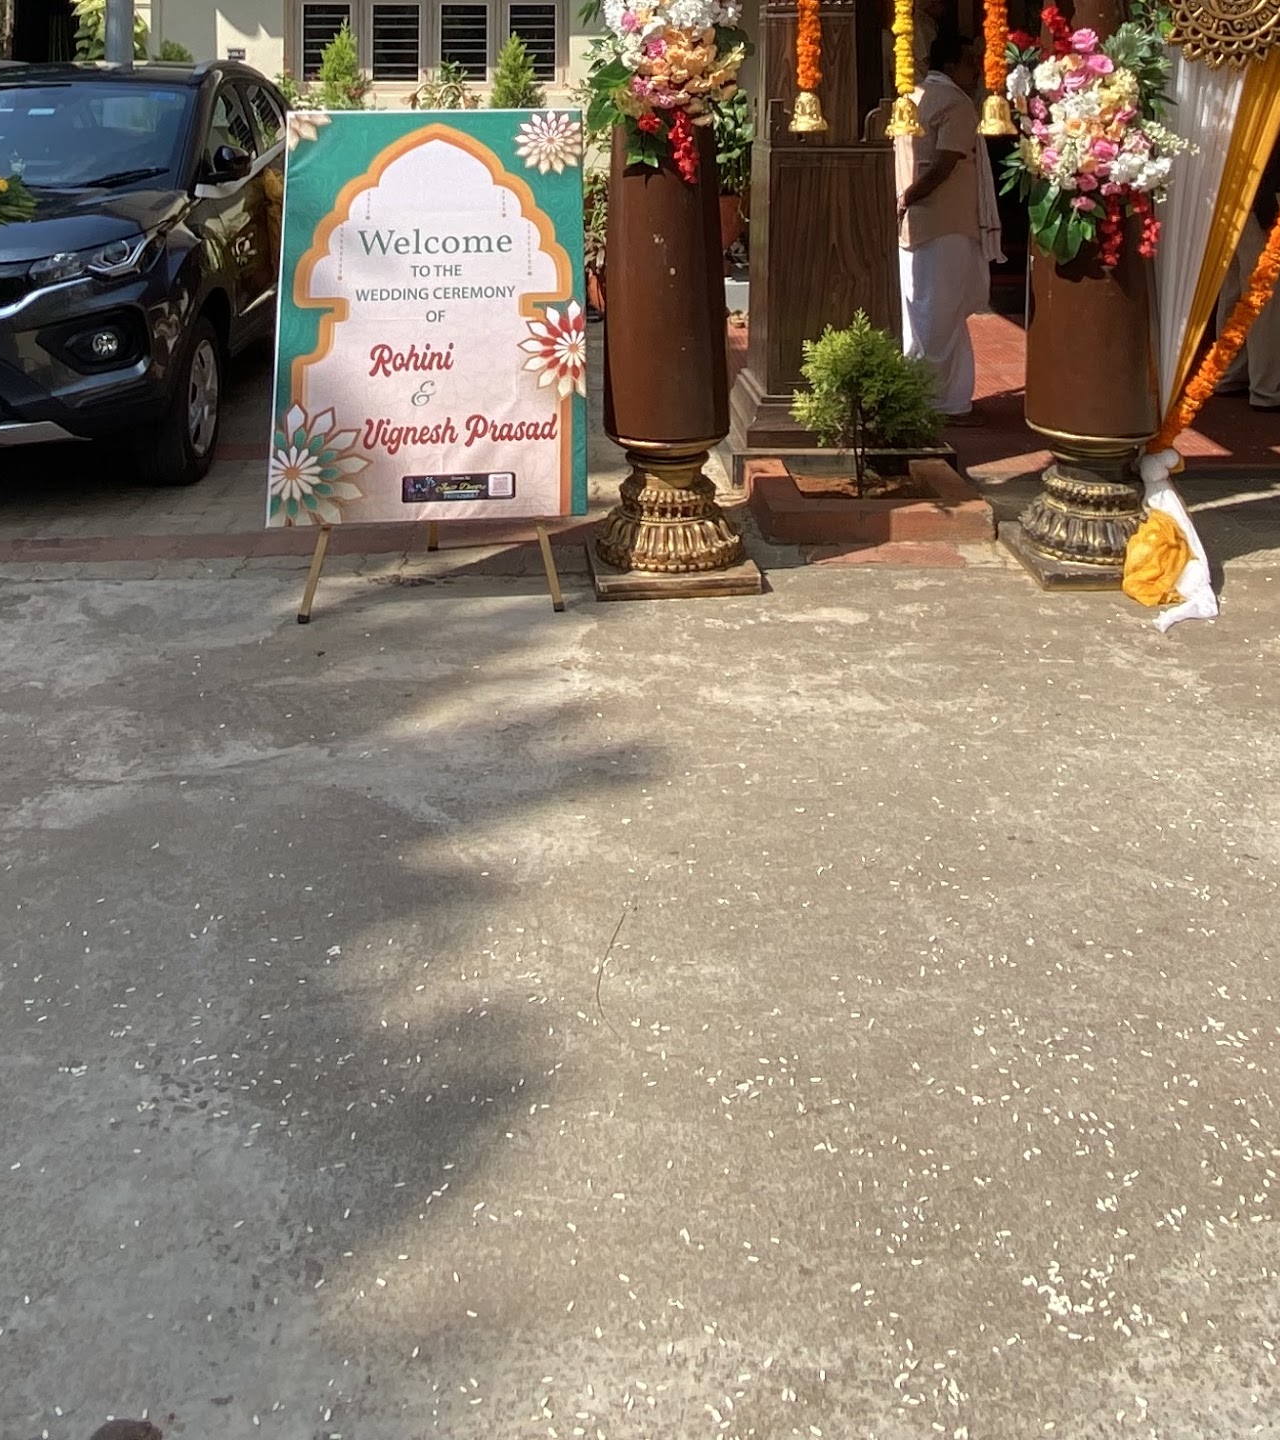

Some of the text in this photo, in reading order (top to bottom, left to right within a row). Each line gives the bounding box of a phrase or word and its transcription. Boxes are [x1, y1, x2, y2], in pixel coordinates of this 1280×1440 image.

[358, 228, 513, 256] Welcome
[410, 264, 463, 278] TO THE
[355, 285, 516, 302] WEDDING CEREMONY
[425, 310, 446, 323] OF
[368, 342, 455, 378] Rohini
[411, 380, 437, 407] &
[363, 413, 558, 455] Vignesh Prasad
